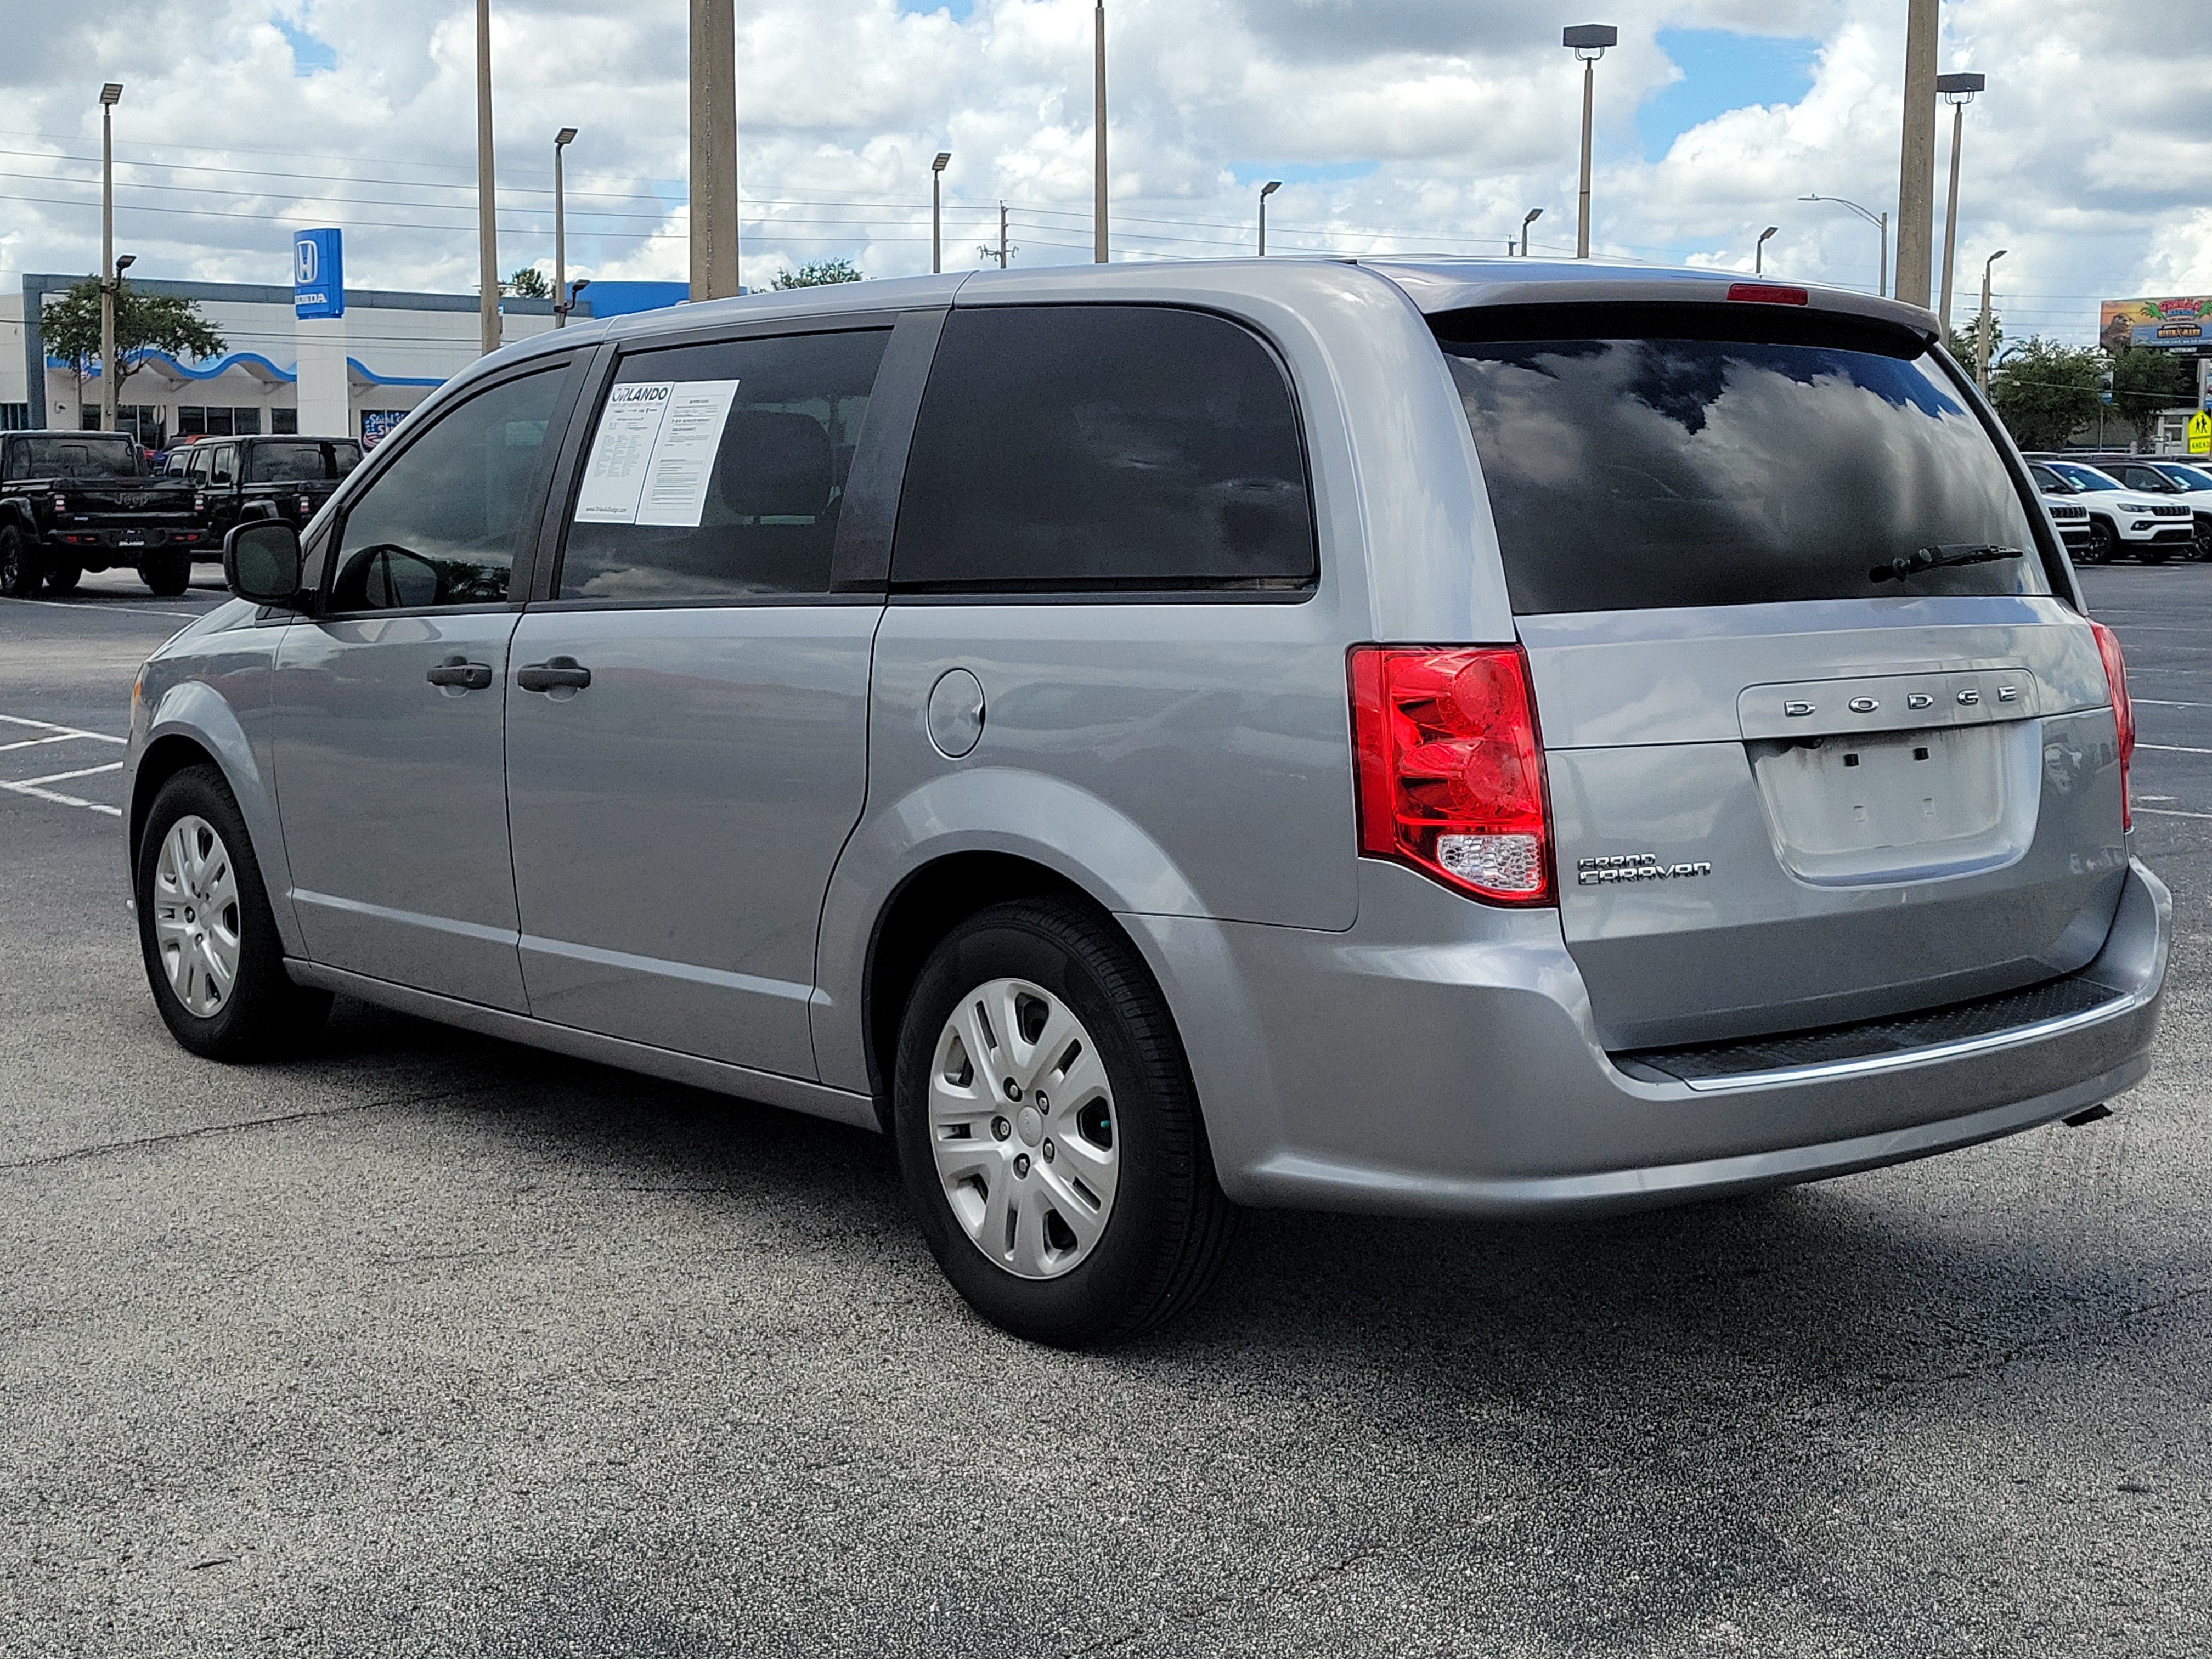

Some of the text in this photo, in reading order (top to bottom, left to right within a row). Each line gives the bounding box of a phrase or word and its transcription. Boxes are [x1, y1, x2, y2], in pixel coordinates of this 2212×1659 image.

[612, 387, 668, 401] ORLANDO
[2192, 441, 2210, 449] AHEAD
[114, 493, 149, 506] Jeep
[1784, 685, 2017, 716] DODGE
[1578, 854, 1656, 870] GRAND
[1579, 862, 1711, 885] CARAVAN
